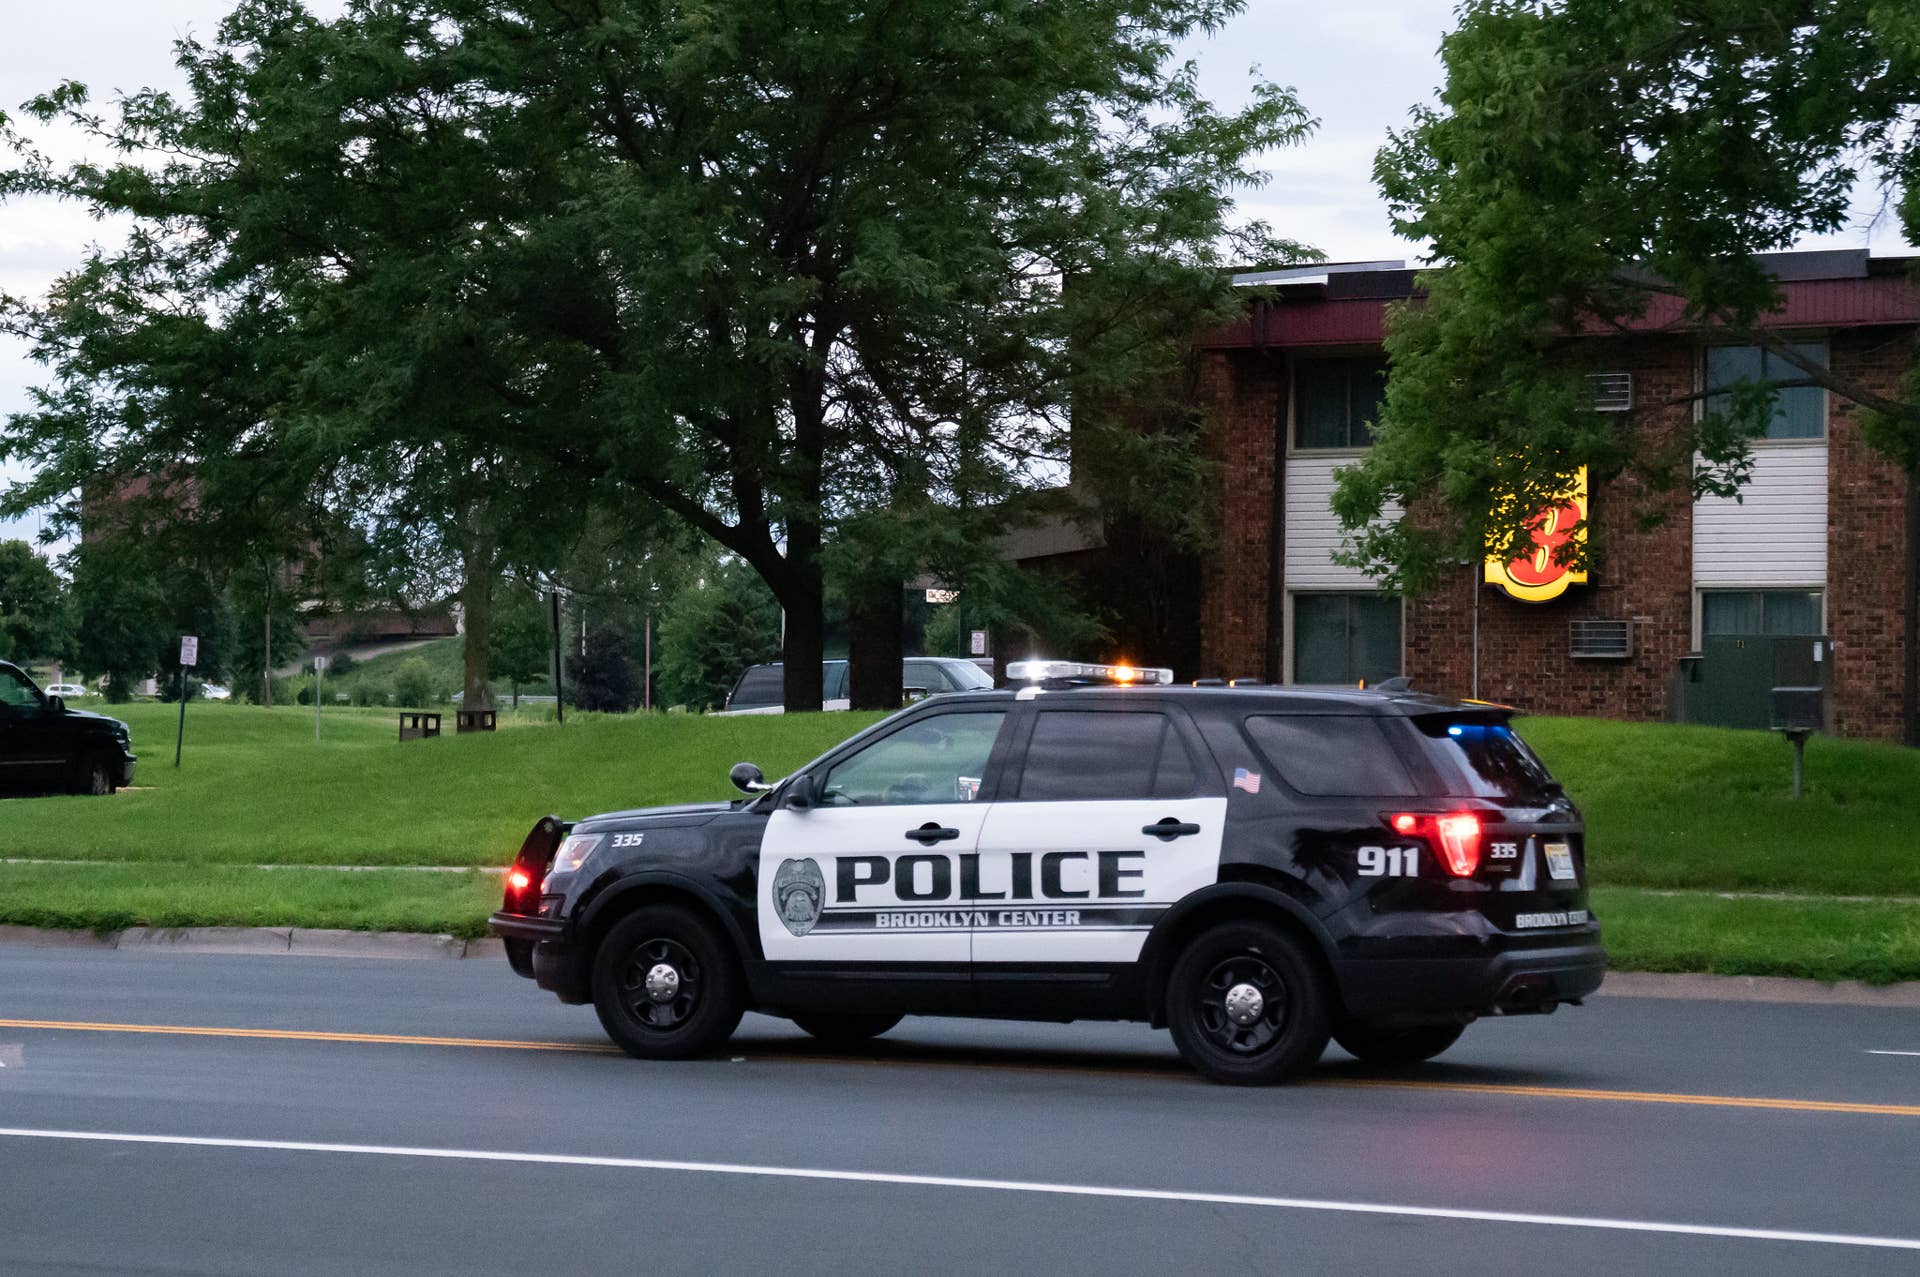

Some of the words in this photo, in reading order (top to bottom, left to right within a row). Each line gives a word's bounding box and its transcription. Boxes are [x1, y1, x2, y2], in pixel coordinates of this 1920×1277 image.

[611, 833, 644, 848] 335
[1490, 843, 1517, 858] 335
[1357, 846, 1419, 877] 911
[835, 851, 1146, 902] POLICE
[875, 910, 989, 929] BROOKLYN
[998, 909, 1080, 926] CENTER
[1516, 912, 1568, 929] BROOKLYN
